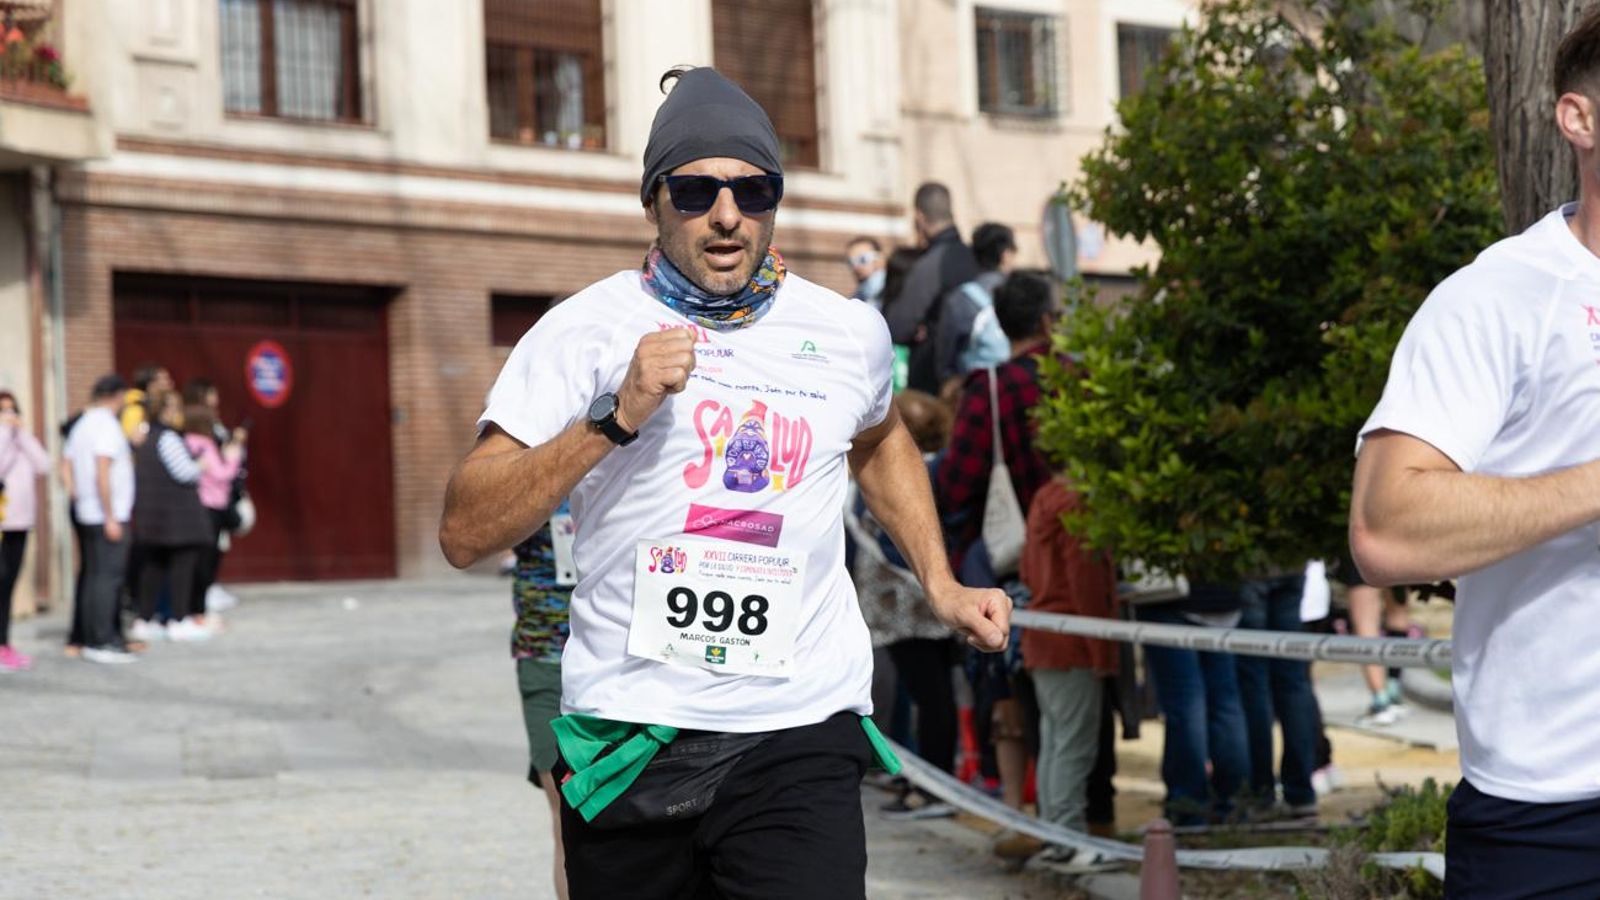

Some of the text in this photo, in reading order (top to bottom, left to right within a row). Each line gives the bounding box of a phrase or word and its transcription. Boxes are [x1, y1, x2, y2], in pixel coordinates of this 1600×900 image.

[683, 399, 813, 489] SALUD
[666, 586, 769, 636] 998
[680, 632, 716, 644] MARCOS
